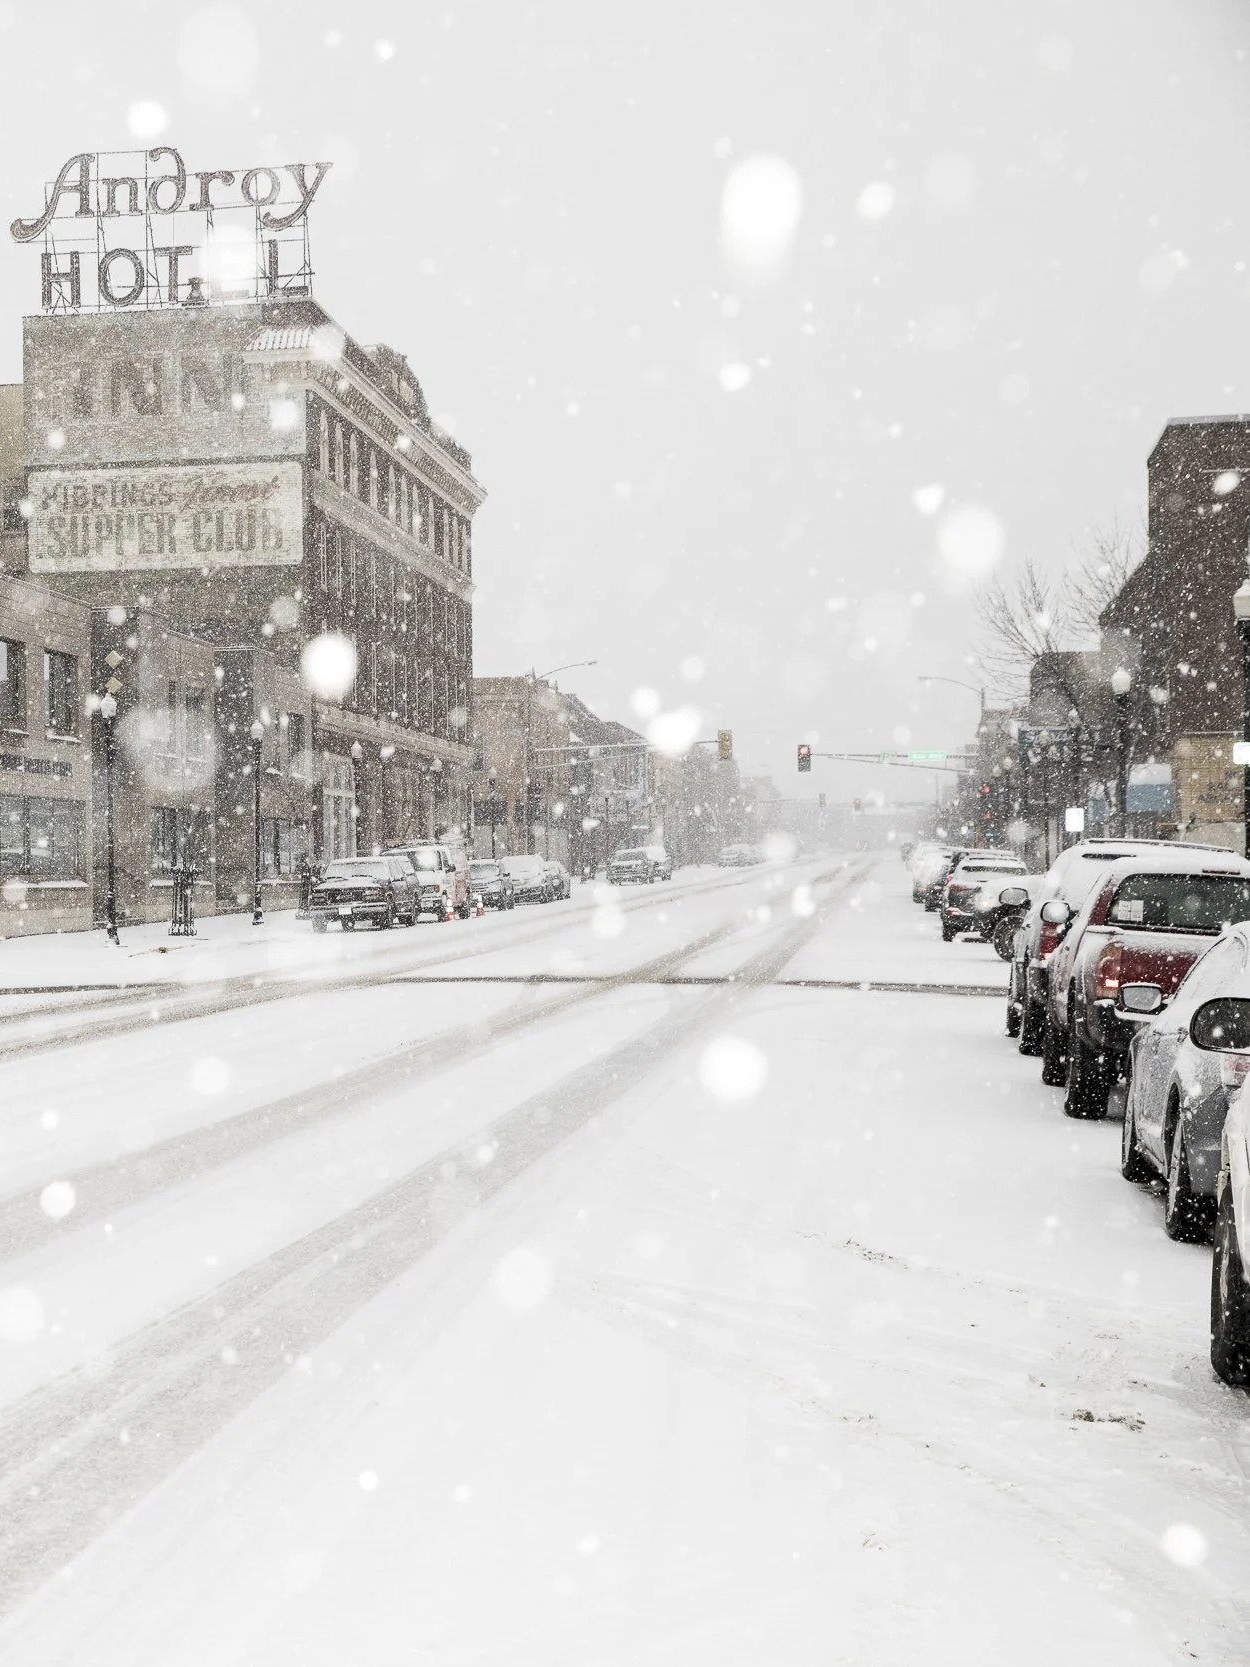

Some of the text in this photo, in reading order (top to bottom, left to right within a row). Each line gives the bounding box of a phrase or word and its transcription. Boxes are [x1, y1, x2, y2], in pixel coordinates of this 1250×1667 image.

[9, 147, 334, 242] Androy
[41, 239, 310, 308] HOTL
[47, 506, 283, 559] SUPPER CLUB
